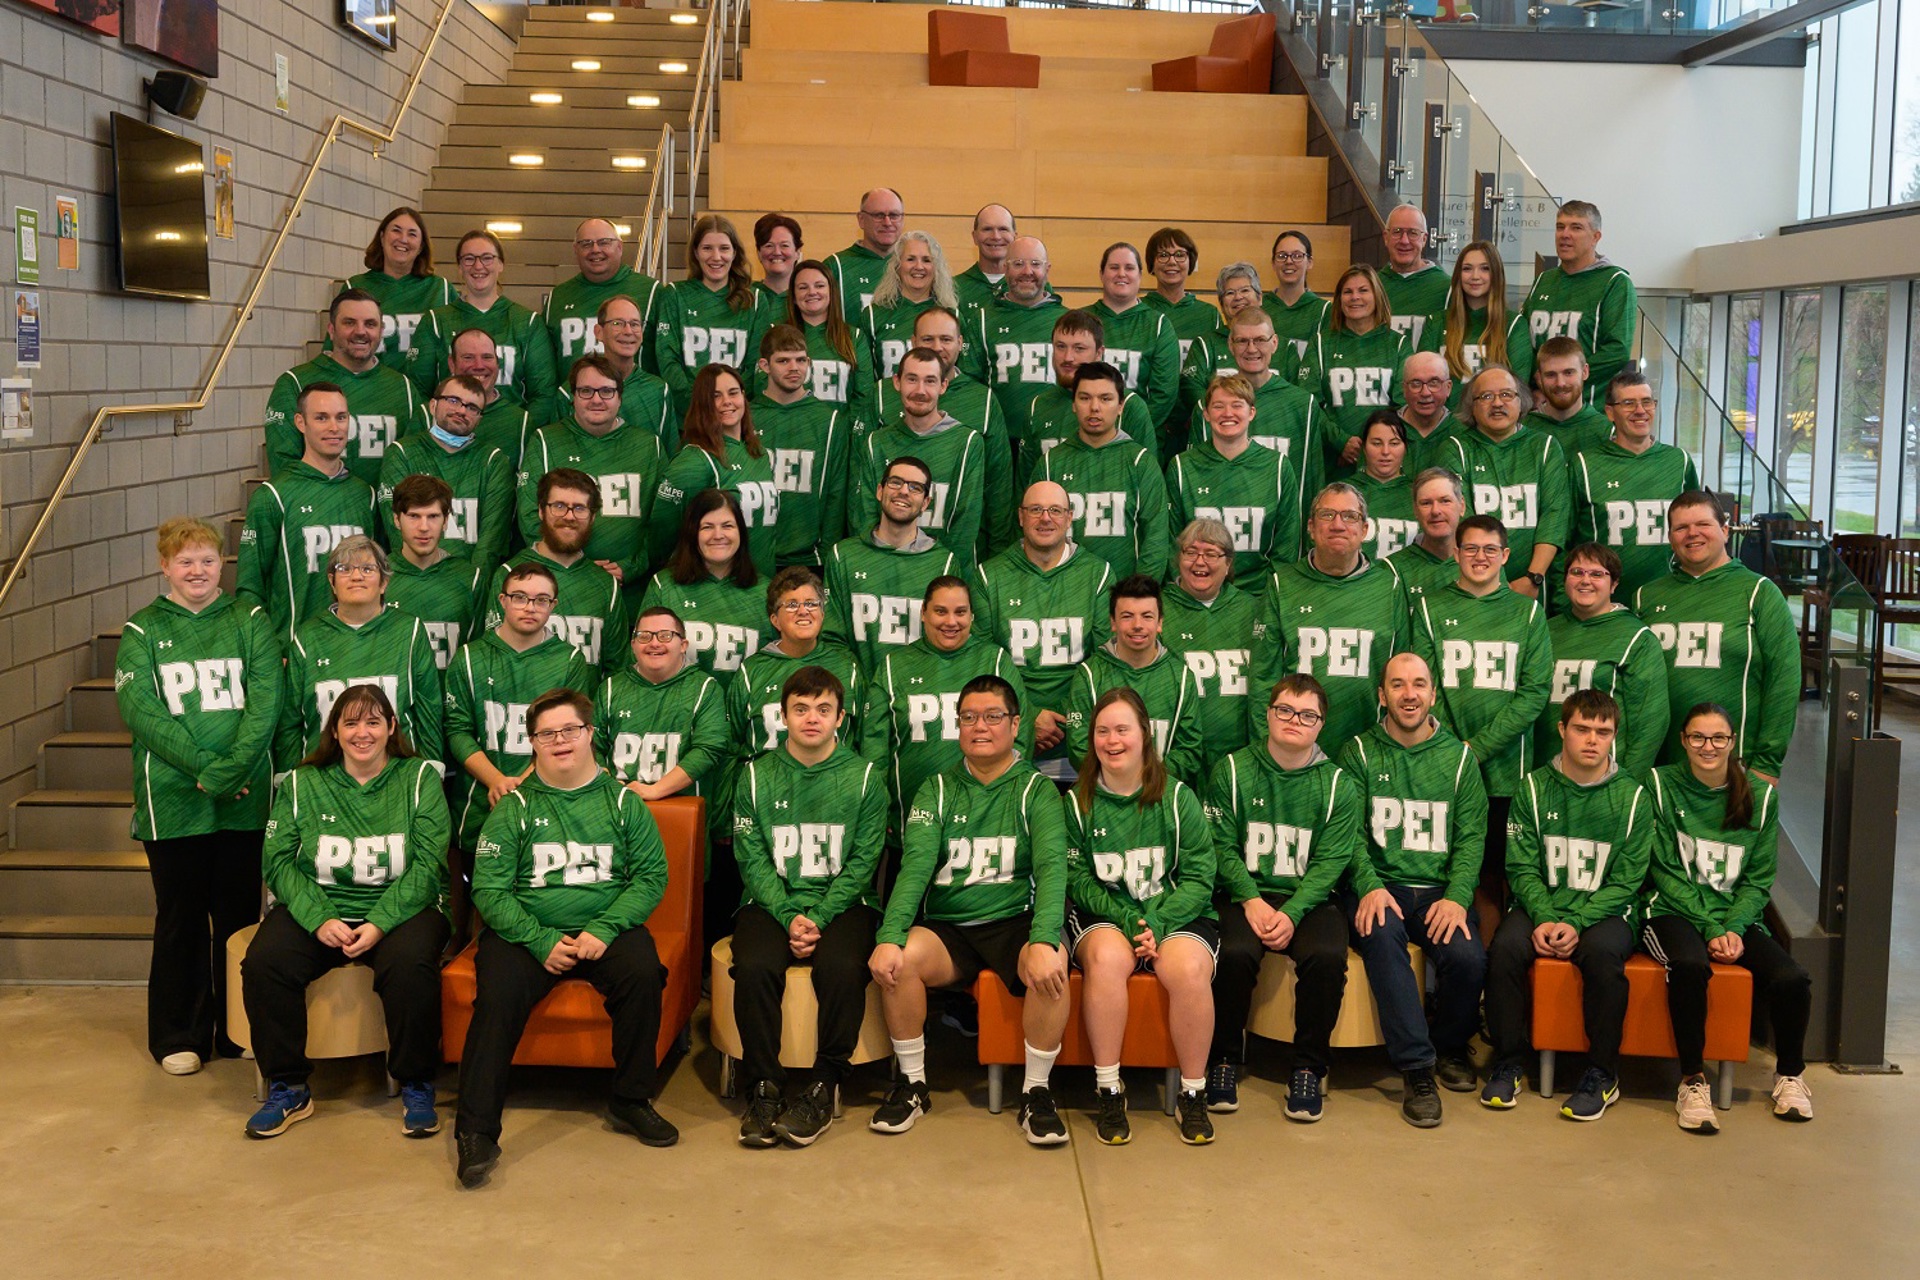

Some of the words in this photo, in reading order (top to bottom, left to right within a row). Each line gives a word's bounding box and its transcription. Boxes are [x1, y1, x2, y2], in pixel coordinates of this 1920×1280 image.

[1538, 203, 1545, 212] B
[376, 314, 424, 352] PE
[683, 327, 747, 367] PEI
[1530, 310, 1582, 350] PEI
[1104, 350, 1142, 389] EI
[1328, 367, 1392, 406] PEI
[597, 473, 640, 517] EI
[771, 448, 814, 493] EI
[445, 498, 478, 544] EI
[736, 480, 780, 527] PE
[1473, 484, 1538, 529] PEI
[851, 593, 923, 645] PEI
[1009, 617, 1084, 666] PEI
[428, 622, 460, 669] EI
[683, 621, 759, 671] PEI
[1297, 626, 1374, 677] PEI
[1442, 640, 1519, 692] PEI
[159, 658, 245, 715] PEI
[1184, 650, 1249, 697] PE
[1550, 659, 1598, 704] EI
[484, 700, 532, 754] PE
[908, 693, 960, 742] PE
[611, 732, 682, 783] PEI
[1372, 796, 1449, 852] PEI
[316, 834, 406, 886] PEI
[530, 840, 613, 887] PEI
[771, 822, 846, 877] PEI
[934, 836, 1016, 886] PEI
[1246, 822, 1312, 876] PEI
[1544, 835, 1611, 892] PEI
[1677, 831, 1745, 892] PEI
